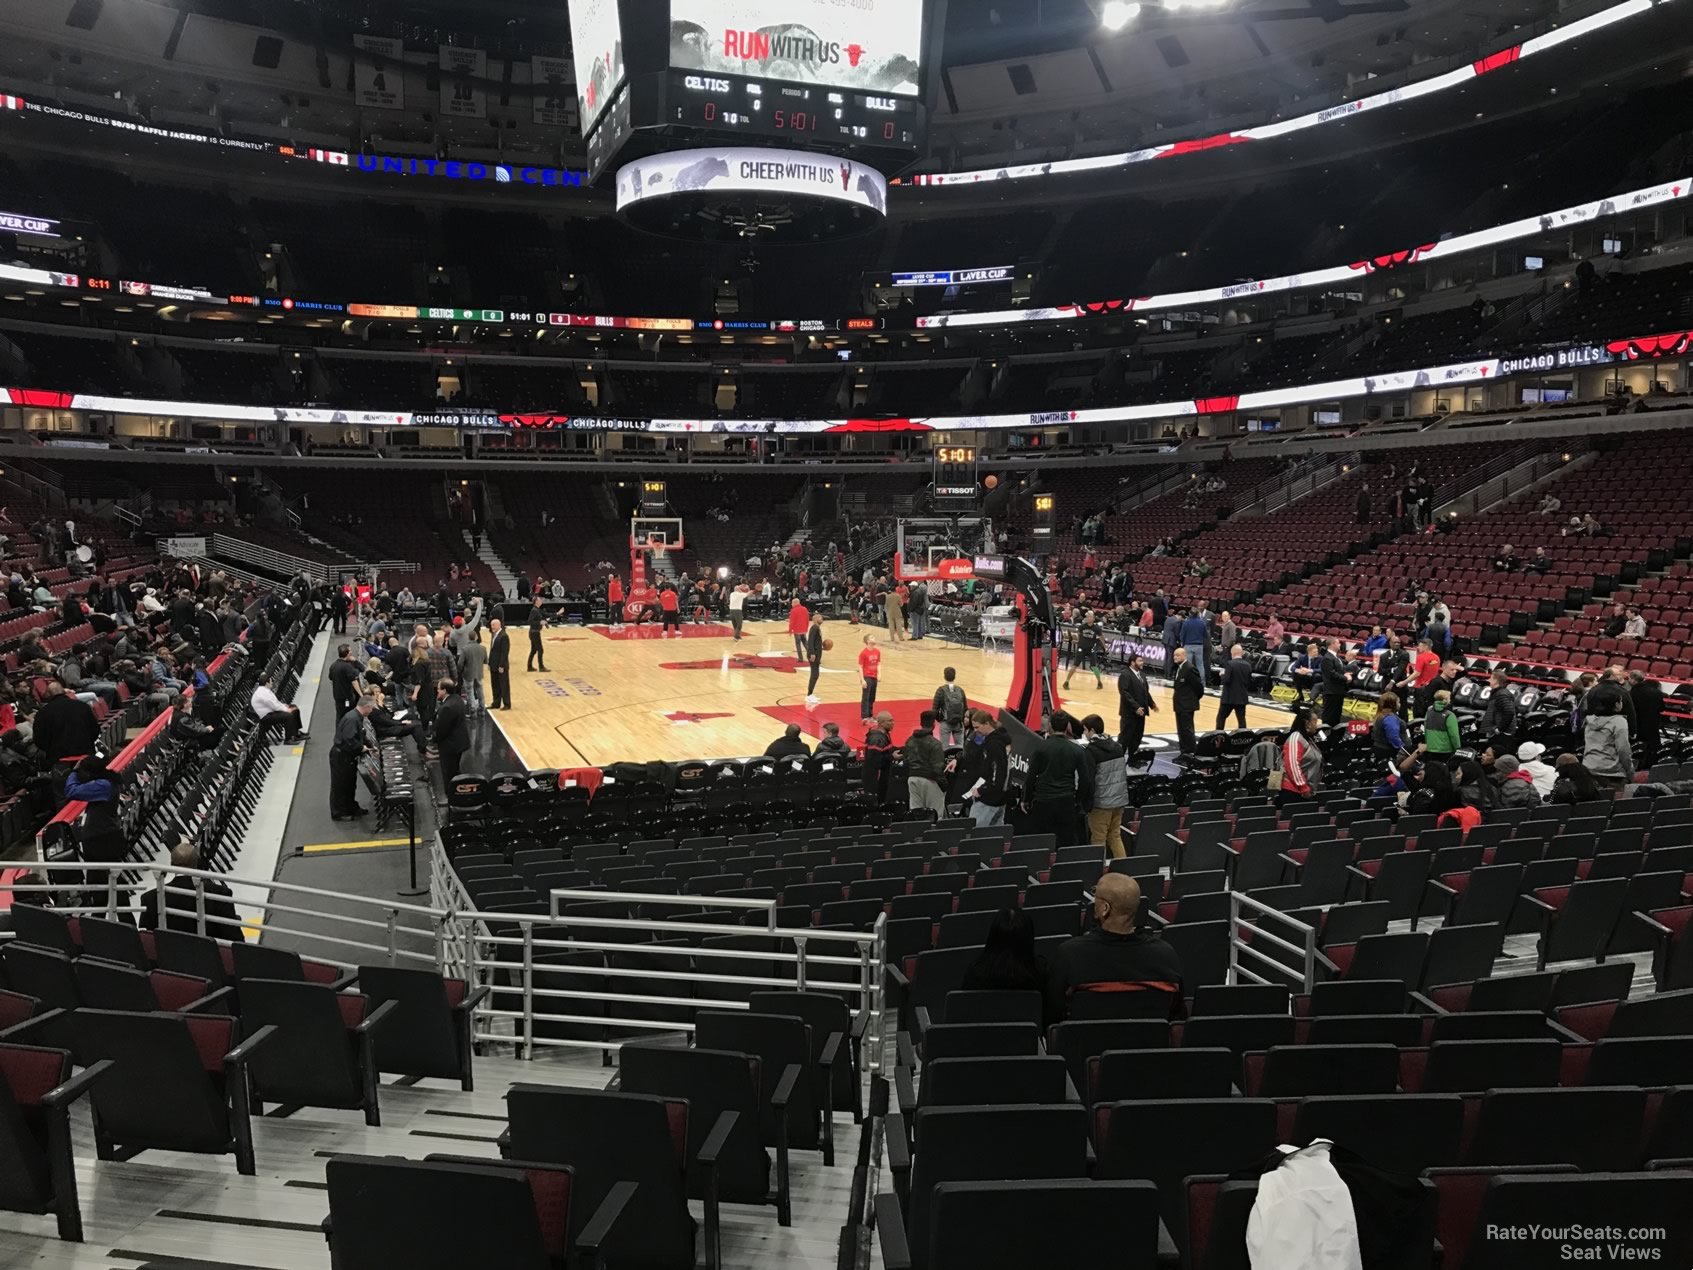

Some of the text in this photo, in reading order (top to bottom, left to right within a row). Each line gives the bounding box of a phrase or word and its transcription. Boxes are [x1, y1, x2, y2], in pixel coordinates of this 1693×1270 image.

[724, 29, 840, 64] RUN WITH US
[684, 76, 730, 93] CELTICS
[782, 88, 802, 97] PERIOD
[753, 99, 760, 111] 0
[865, 96, 896, 111] BULLS
[704, 102, 715, 121] 0
[834, 108, 842, 119] 0
[25, 102, 41, 112] THE
[43, 105, 83, 120] CHICAGO
[84, 114, 109, 126] BULLS
[111, 119, 136, 131] 50/50
[137, 124, 168, 137] RAFFLE
[169, 130, 207, 142] JACKPOT
[219, 138, 263, 151] CURRENTLY
[884, 122, 895, 140] 0
[357, 153, 590, 187] UNITED CEN
[740, 161, 834, 184] CHEER WITH US
[960, 269, 1007, 281] LAVER CUP
[88, 278, 110, 290] 6:11
[295, 301, 323, 309] HARRIS
[429, 308, 454, 319] CELTICS
[510, 312, 531, 321] 51:01
[595, 316, 614, 326] BULLS
[1502, 348, 1600, 372] CHICAGO BULLS
[416, 414, 494, 425] CHICAGO BULLS
[573, 418, 646, 429] CHICAGO BULLS
[1030, 411, 1069, 425] RUN WITH US
[1357, 668, 1369, 679] G
[1461, 683, 1473, 696] G
[1481, 686, 1492, 699] G
[1521, 693, 1534, 706] G
[681, 768, 703, 777] CST
[456, 784, 480, 793] CST
